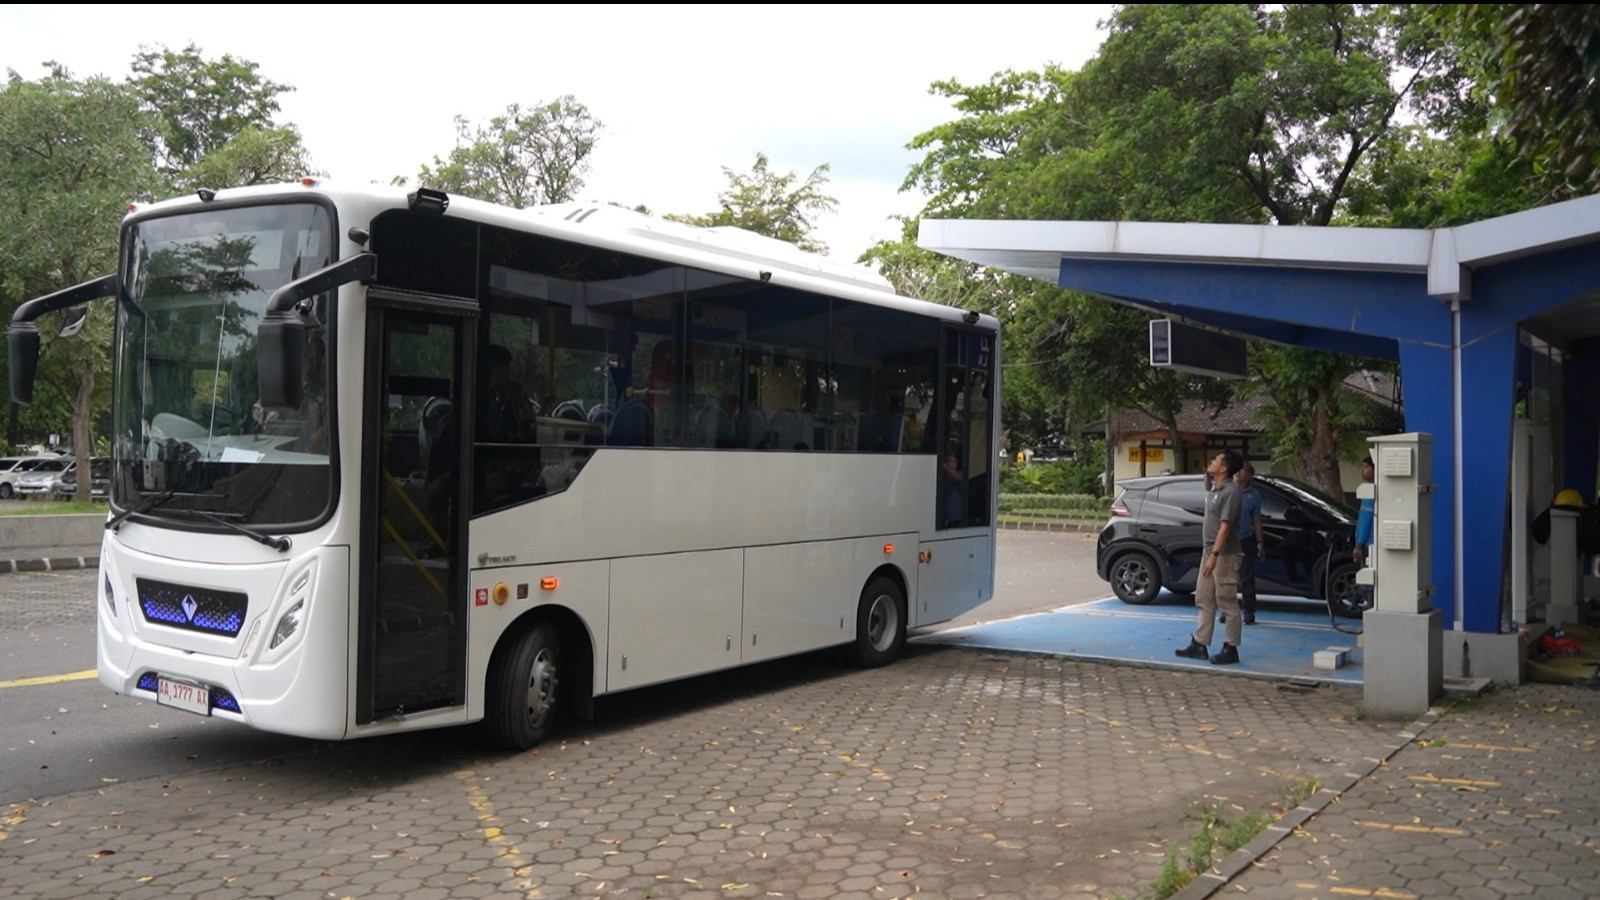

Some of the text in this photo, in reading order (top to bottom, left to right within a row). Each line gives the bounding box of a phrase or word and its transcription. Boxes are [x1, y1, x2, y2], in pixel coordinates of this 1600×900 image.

[1140, 449, 1162, 458] TILET
[160, 680, 169, 696] AA
[173, 684, 193, 702] 1777
